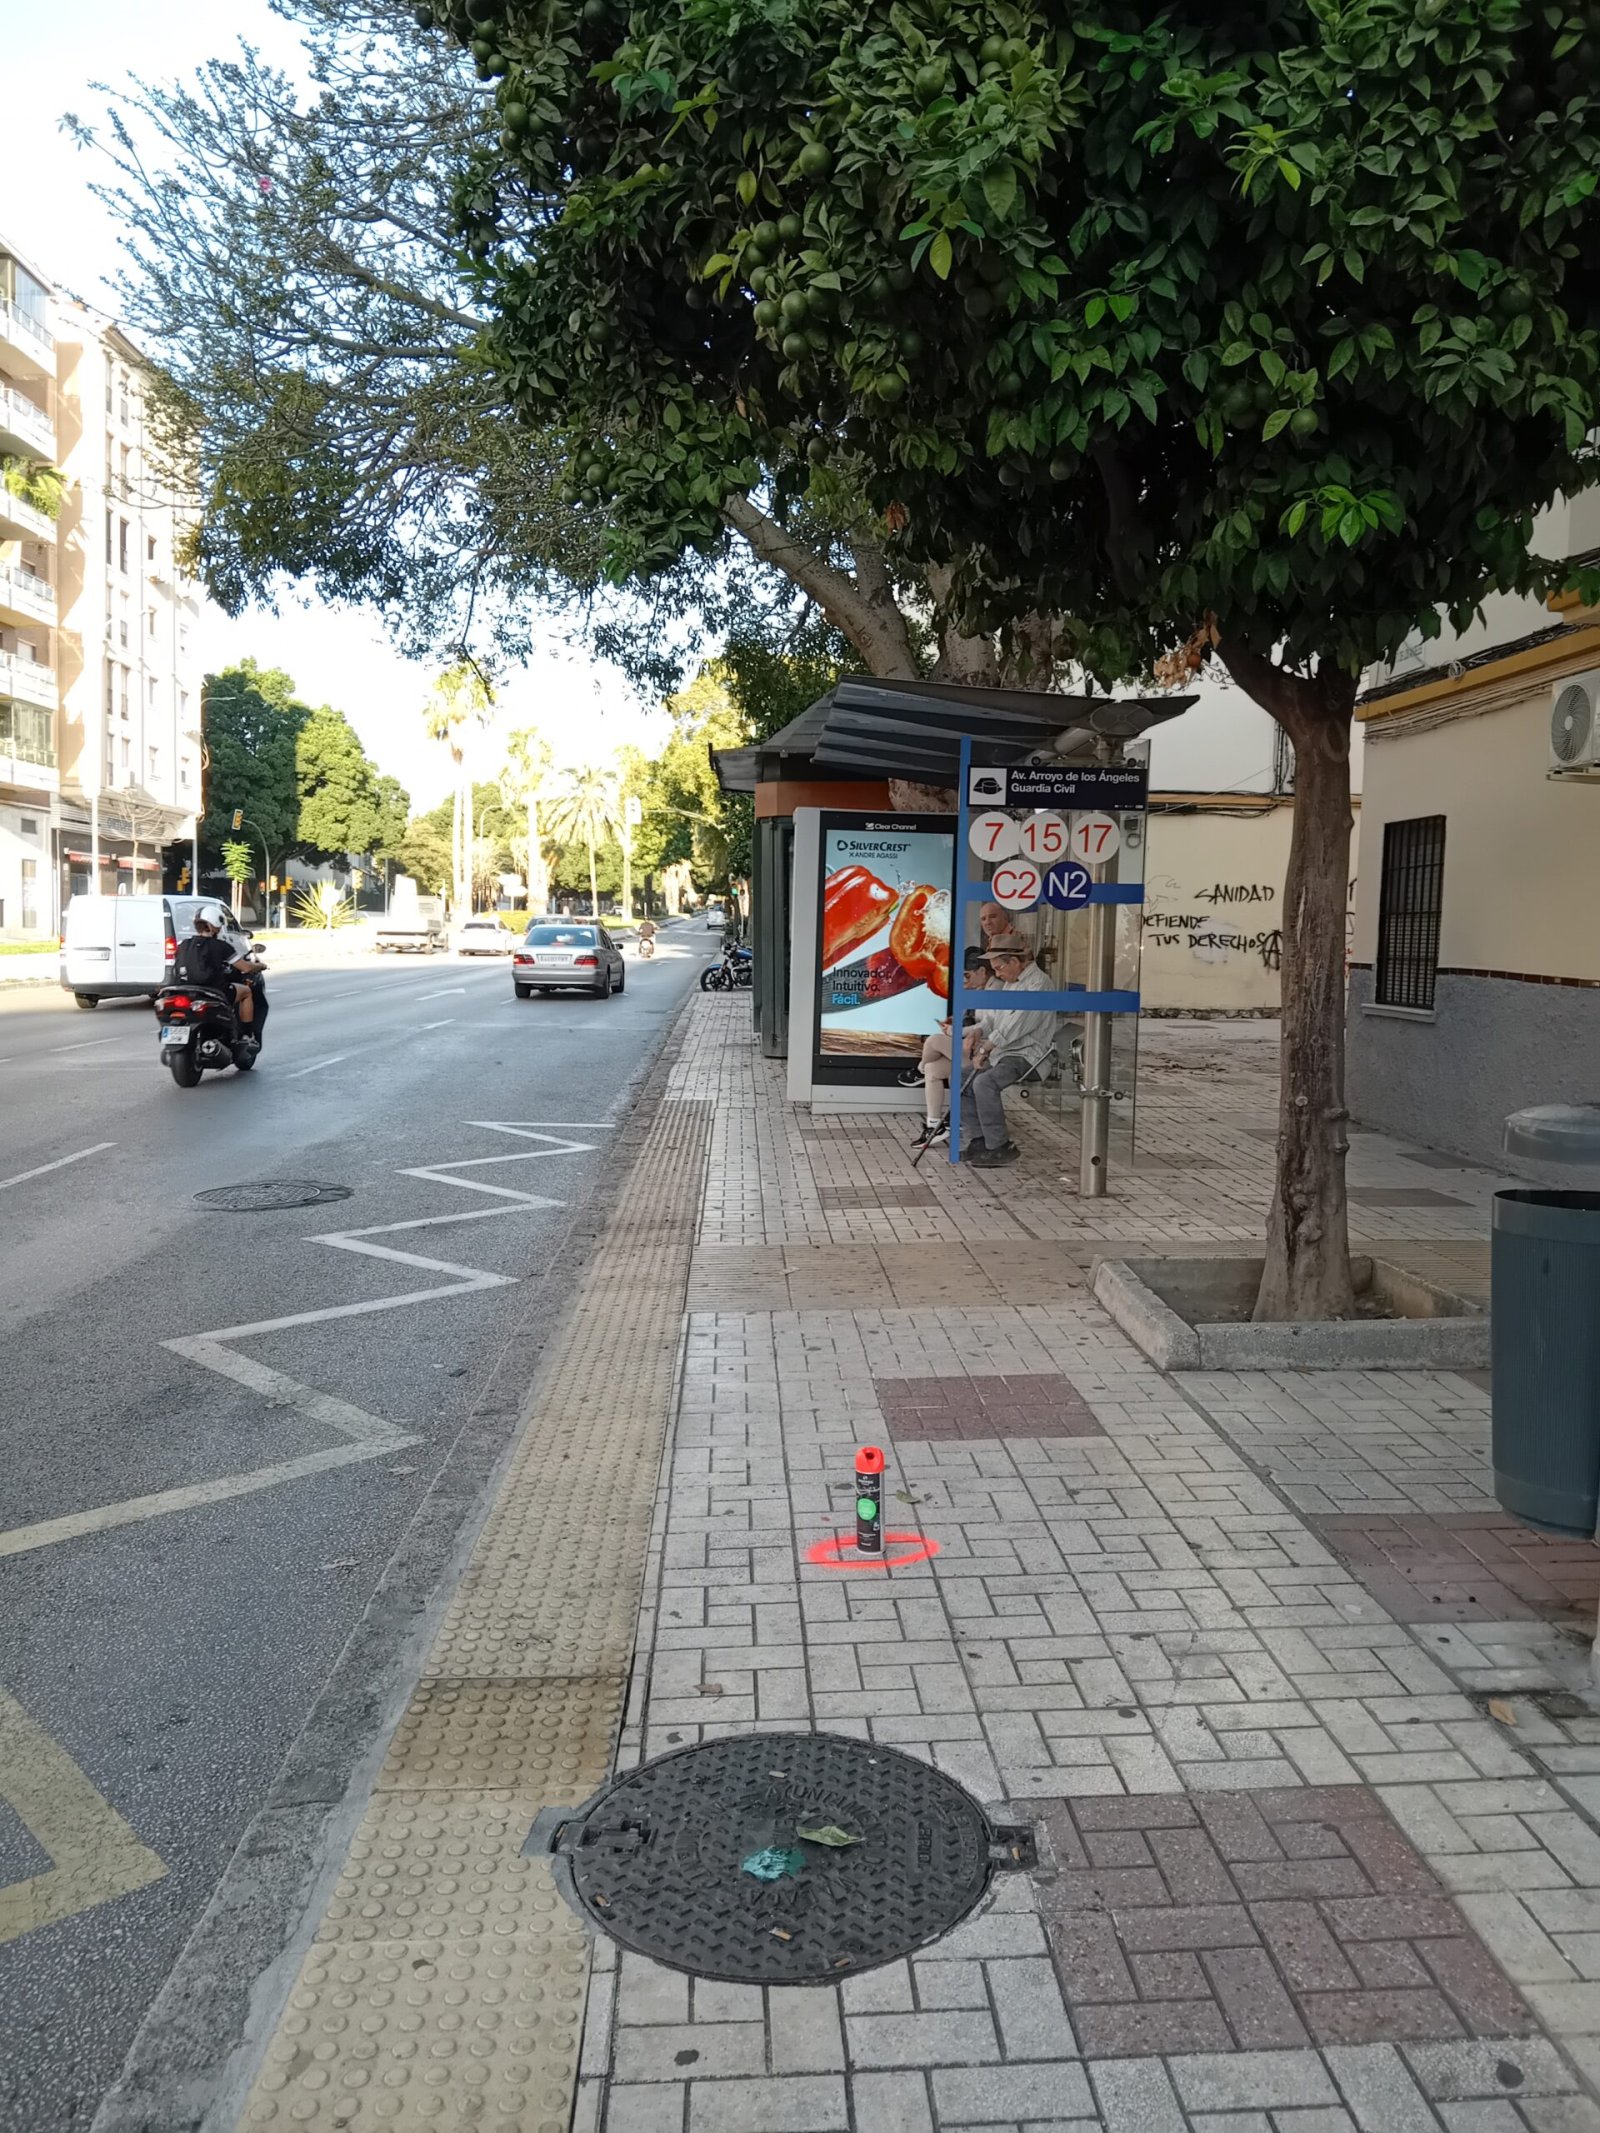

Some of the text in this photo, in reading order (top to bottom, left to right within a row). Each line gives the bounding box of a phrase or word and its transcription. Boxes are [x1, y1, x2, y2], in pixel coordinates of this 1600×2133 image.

[1011, 769, 1140, 784] Av. Arroyo de los Ángeles
[1011, 783, 1076, 794] Guardia Civil
[874, 823, 917, 831] Clear Channel
[985, 822, 1112, 853] 7 15 17
[993, 870, 1087, 899] C2 N2
[1194, 884, 1274, 905] SANIDAD
[1148, 933, 1180, 947] TUS
[833, 966, 892, 978] Innovador.
[832, 980, 881, 992] Intuitivo.
[832, 993, 860, 1005] Fácil.
